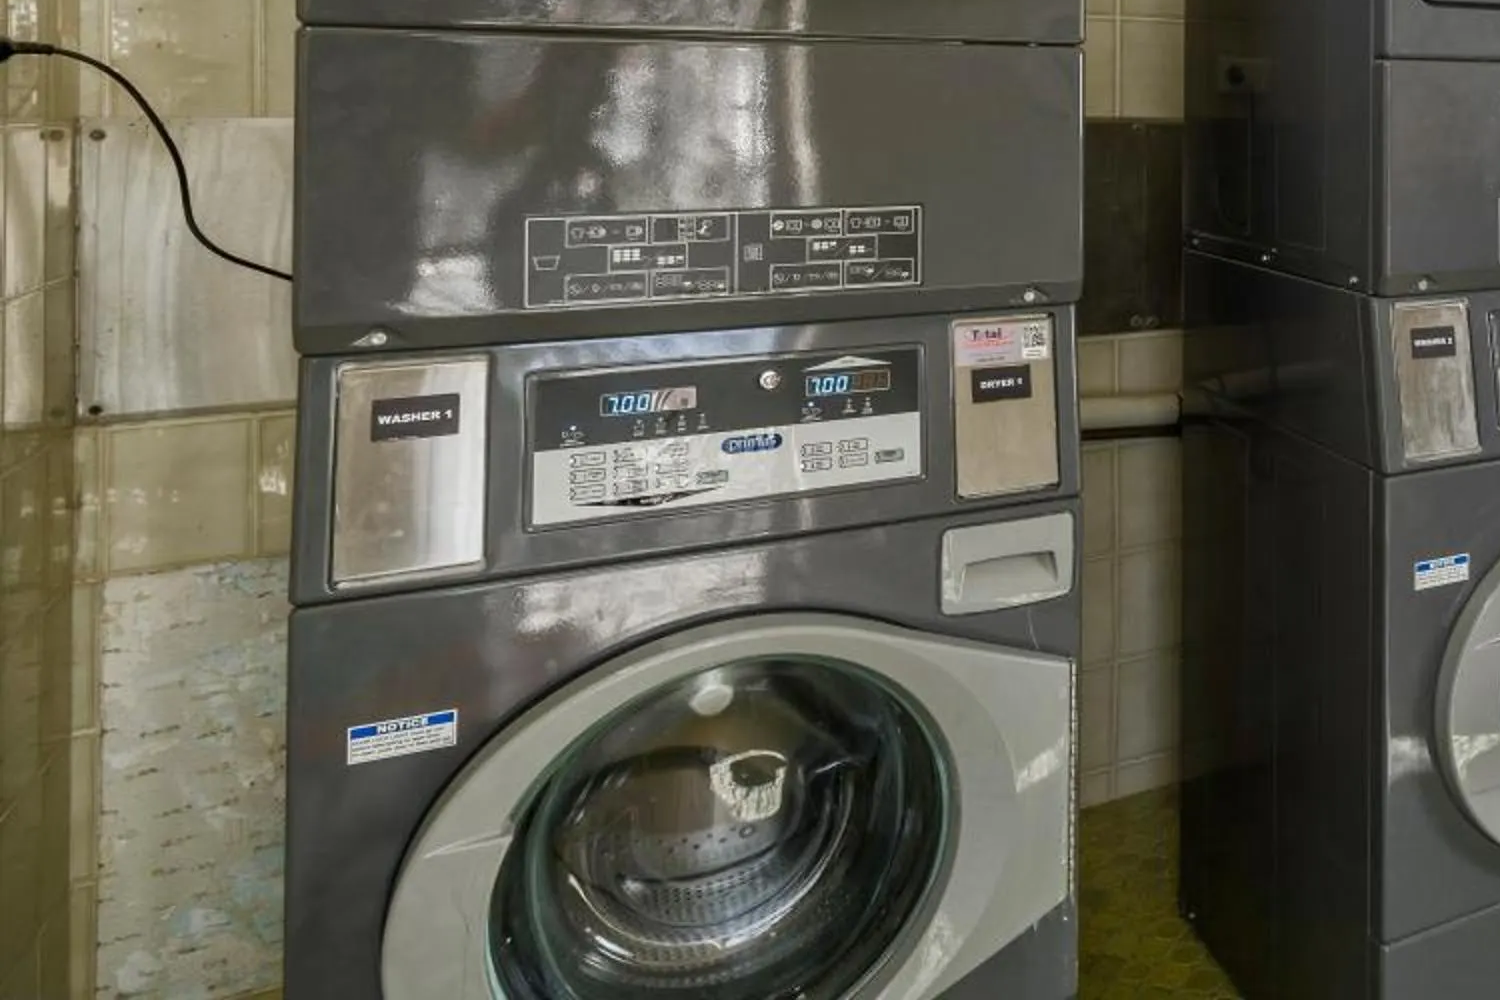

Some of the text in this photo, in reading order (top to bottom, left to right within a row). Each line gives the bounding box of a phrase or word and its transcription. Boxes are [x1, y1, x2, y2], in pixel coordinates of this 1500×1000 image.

[972, 328, 1002, 341] Ttal
[377, 409, 452, 425] WASHER 1
[377, 717, 429, 734] NOTICE
